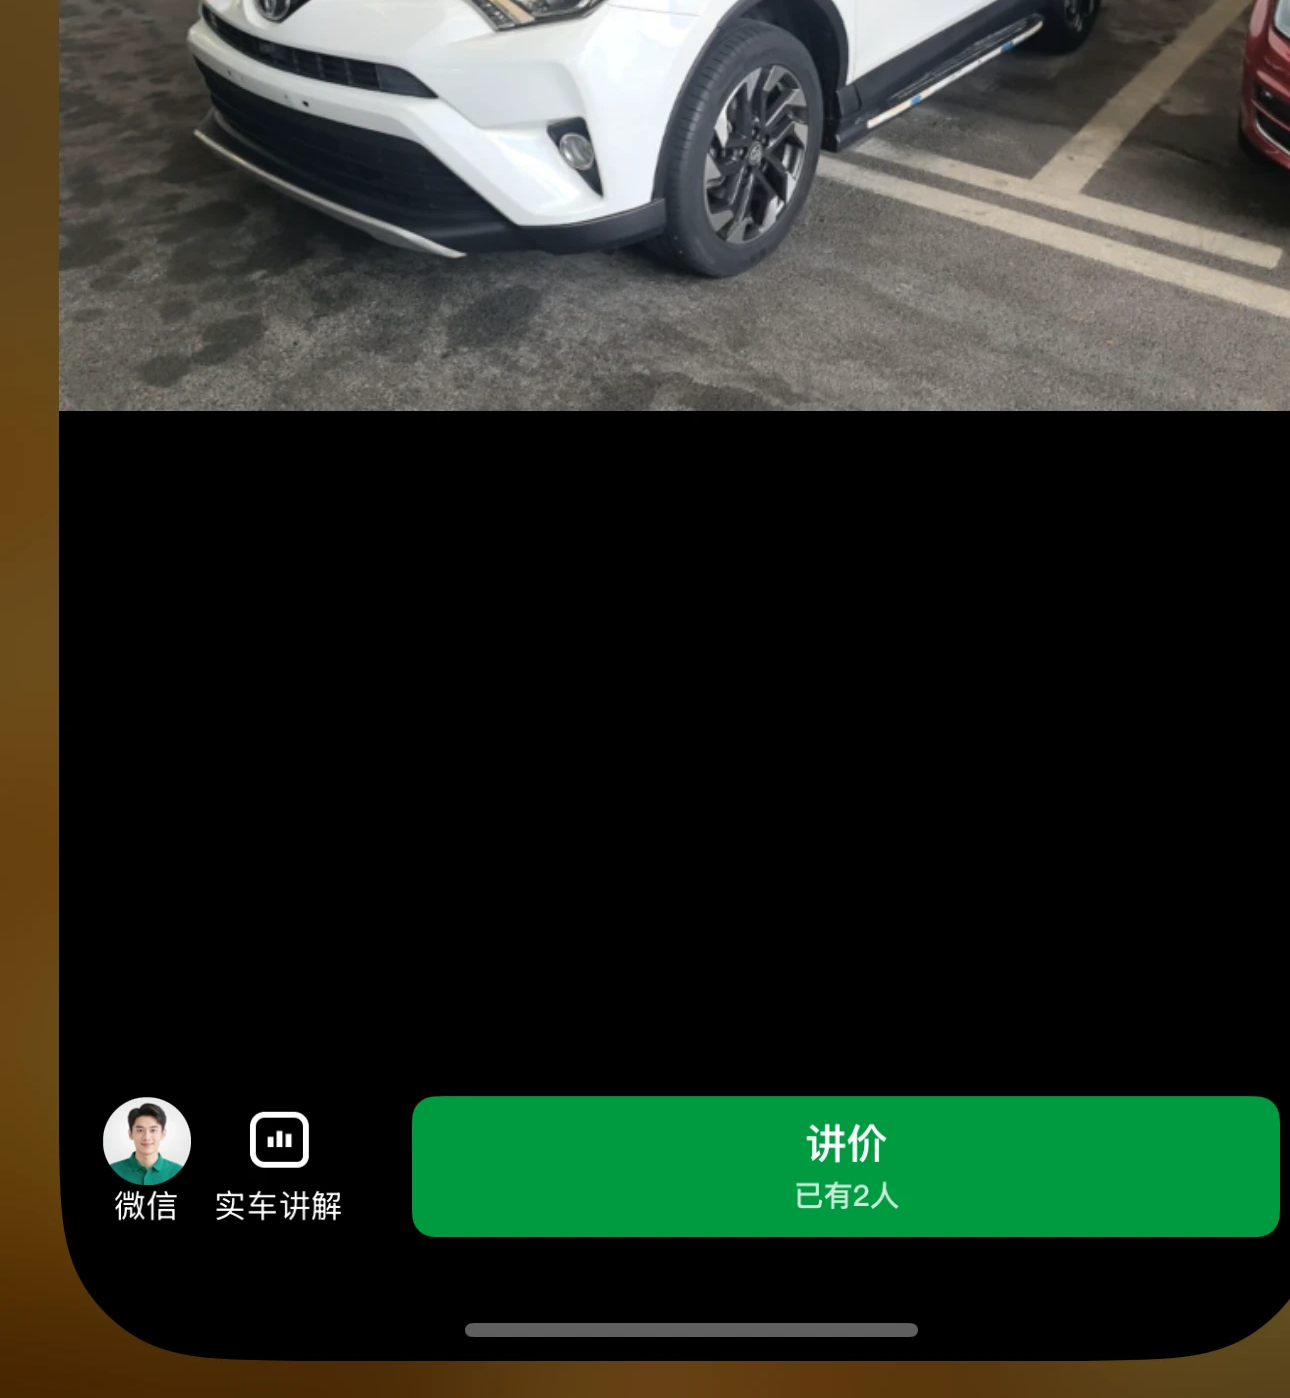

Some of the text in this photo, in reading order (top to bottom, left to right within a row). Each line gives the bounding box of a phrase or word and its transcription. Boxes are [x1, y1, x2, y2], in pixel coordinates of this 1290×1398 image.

[806, 1123, 887, 1163] 讲价
[114, 1190, 178, 1221] 微信
[215, 1189, 342, 1221] 实车讲解
[795, 1181, 899, 1210] 已有2人
